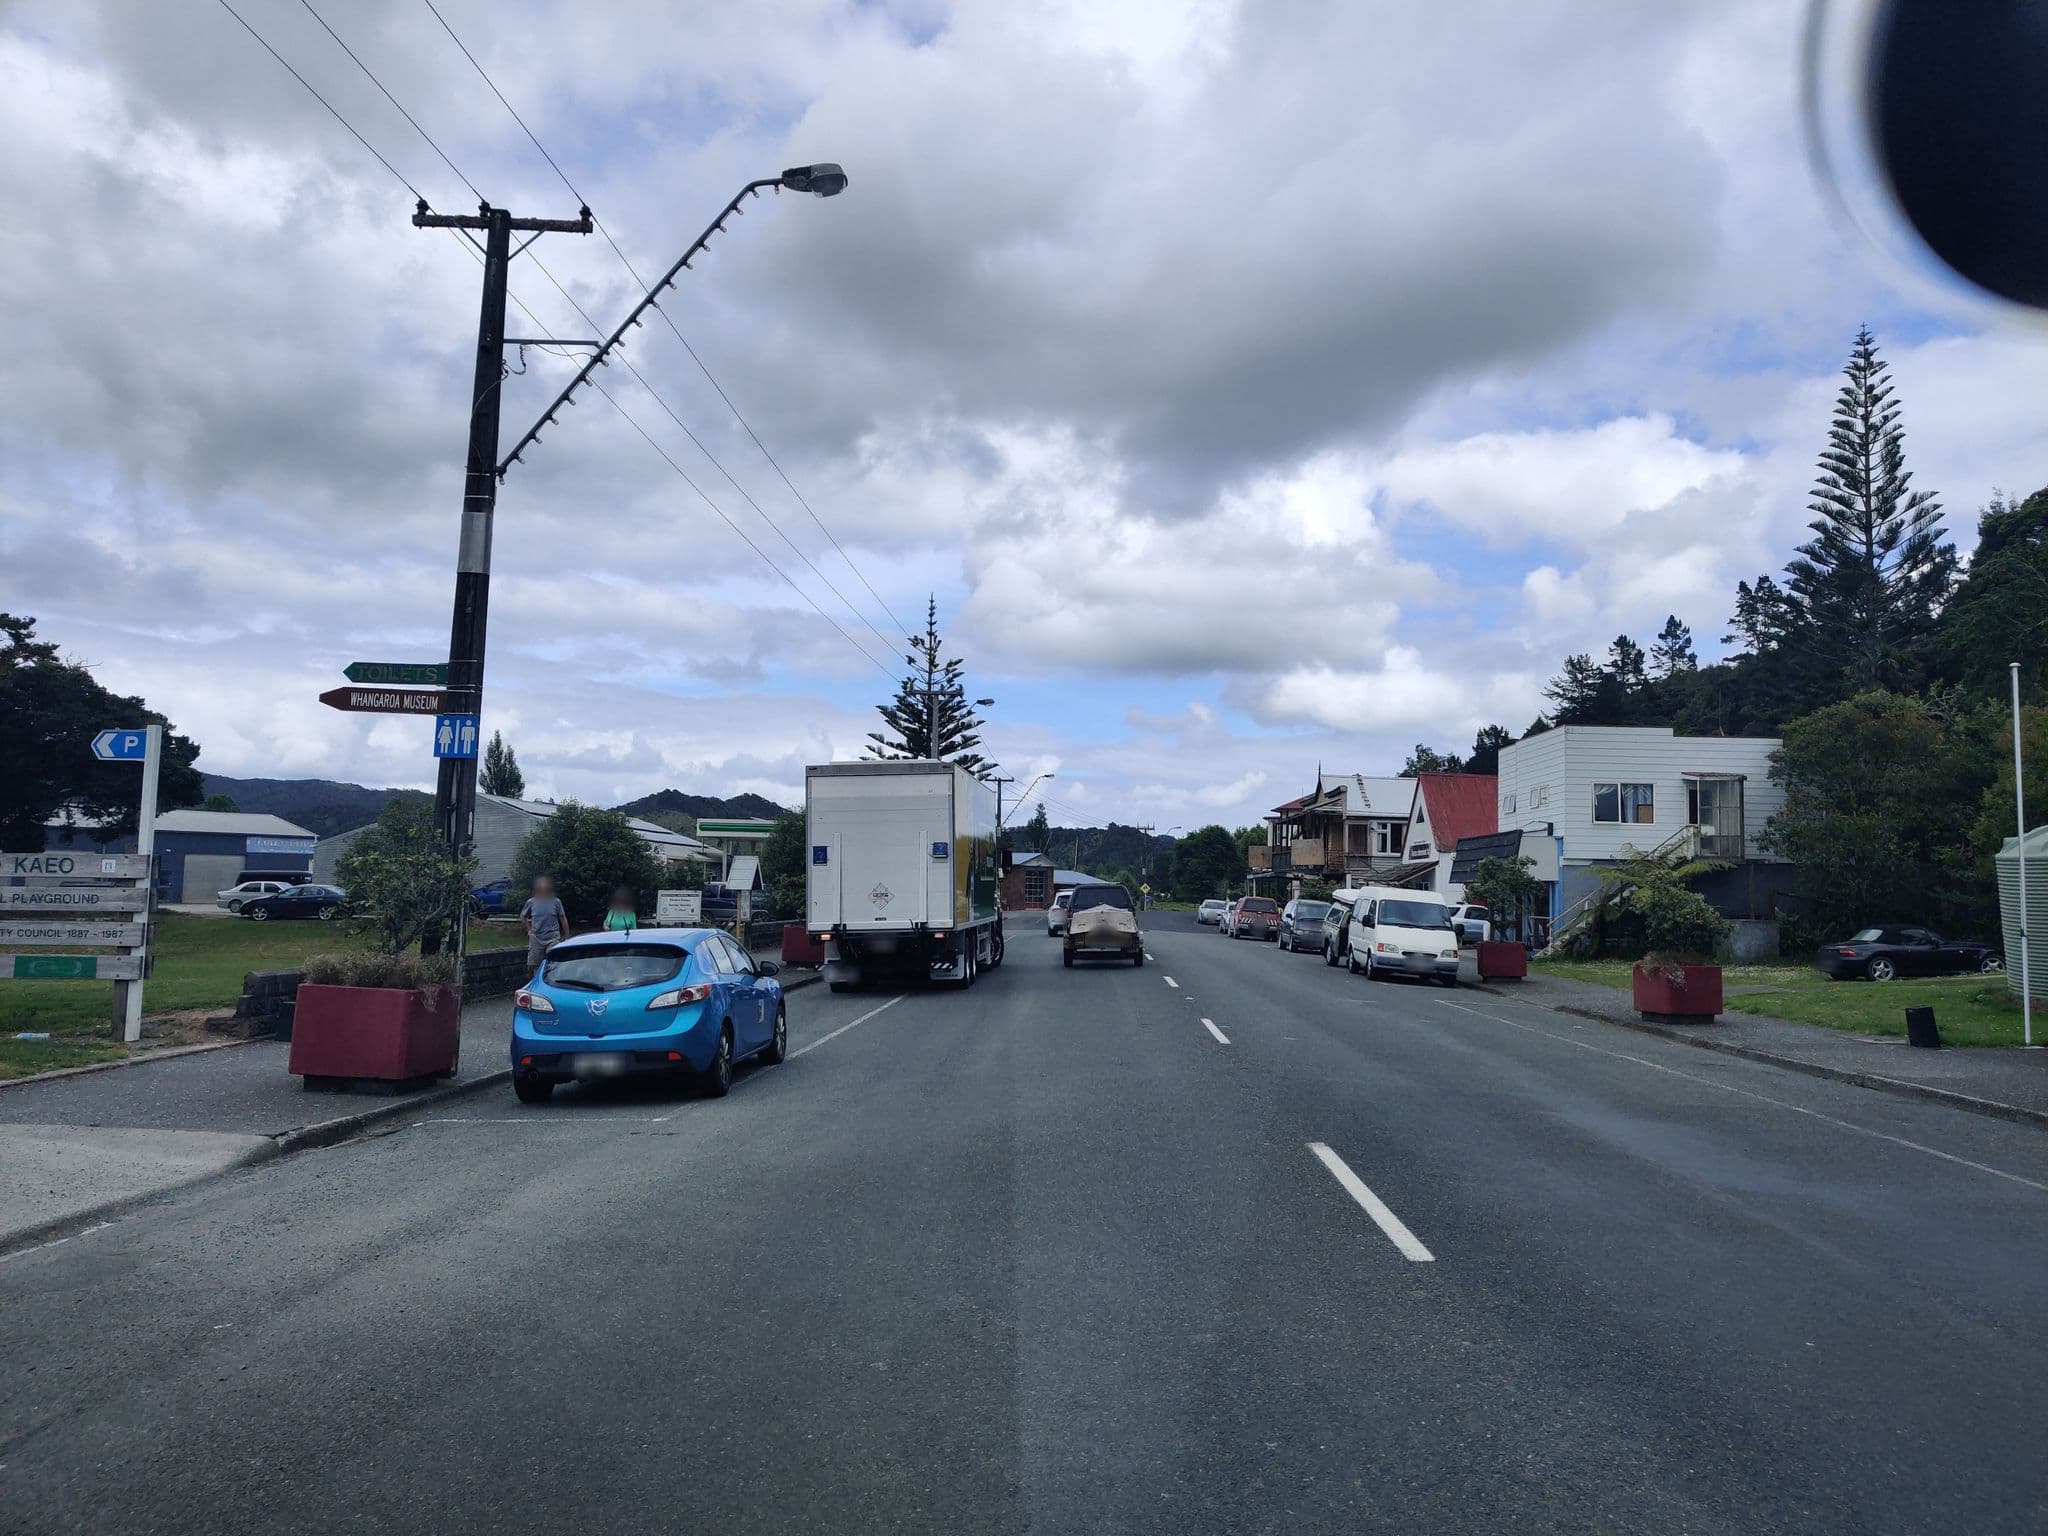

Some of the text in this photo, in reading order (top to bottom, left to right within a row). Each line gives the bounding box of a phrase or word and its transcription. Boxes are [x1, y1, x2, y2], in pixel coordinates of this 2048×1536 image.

[356, 664, 438, 682] TOILETS
[350, 692, 439, 710] WHANGAROA MUSEUM
[124, 736, 139, 752] P
[14, 856, 75, 874] KAEO
[12, 893, 100, 904] PLAYGROUND
[16, 928, 62, 938] COUNCIL
[66, 929, 90, 939] 1887
[102, 930, 124, 939] 1987
